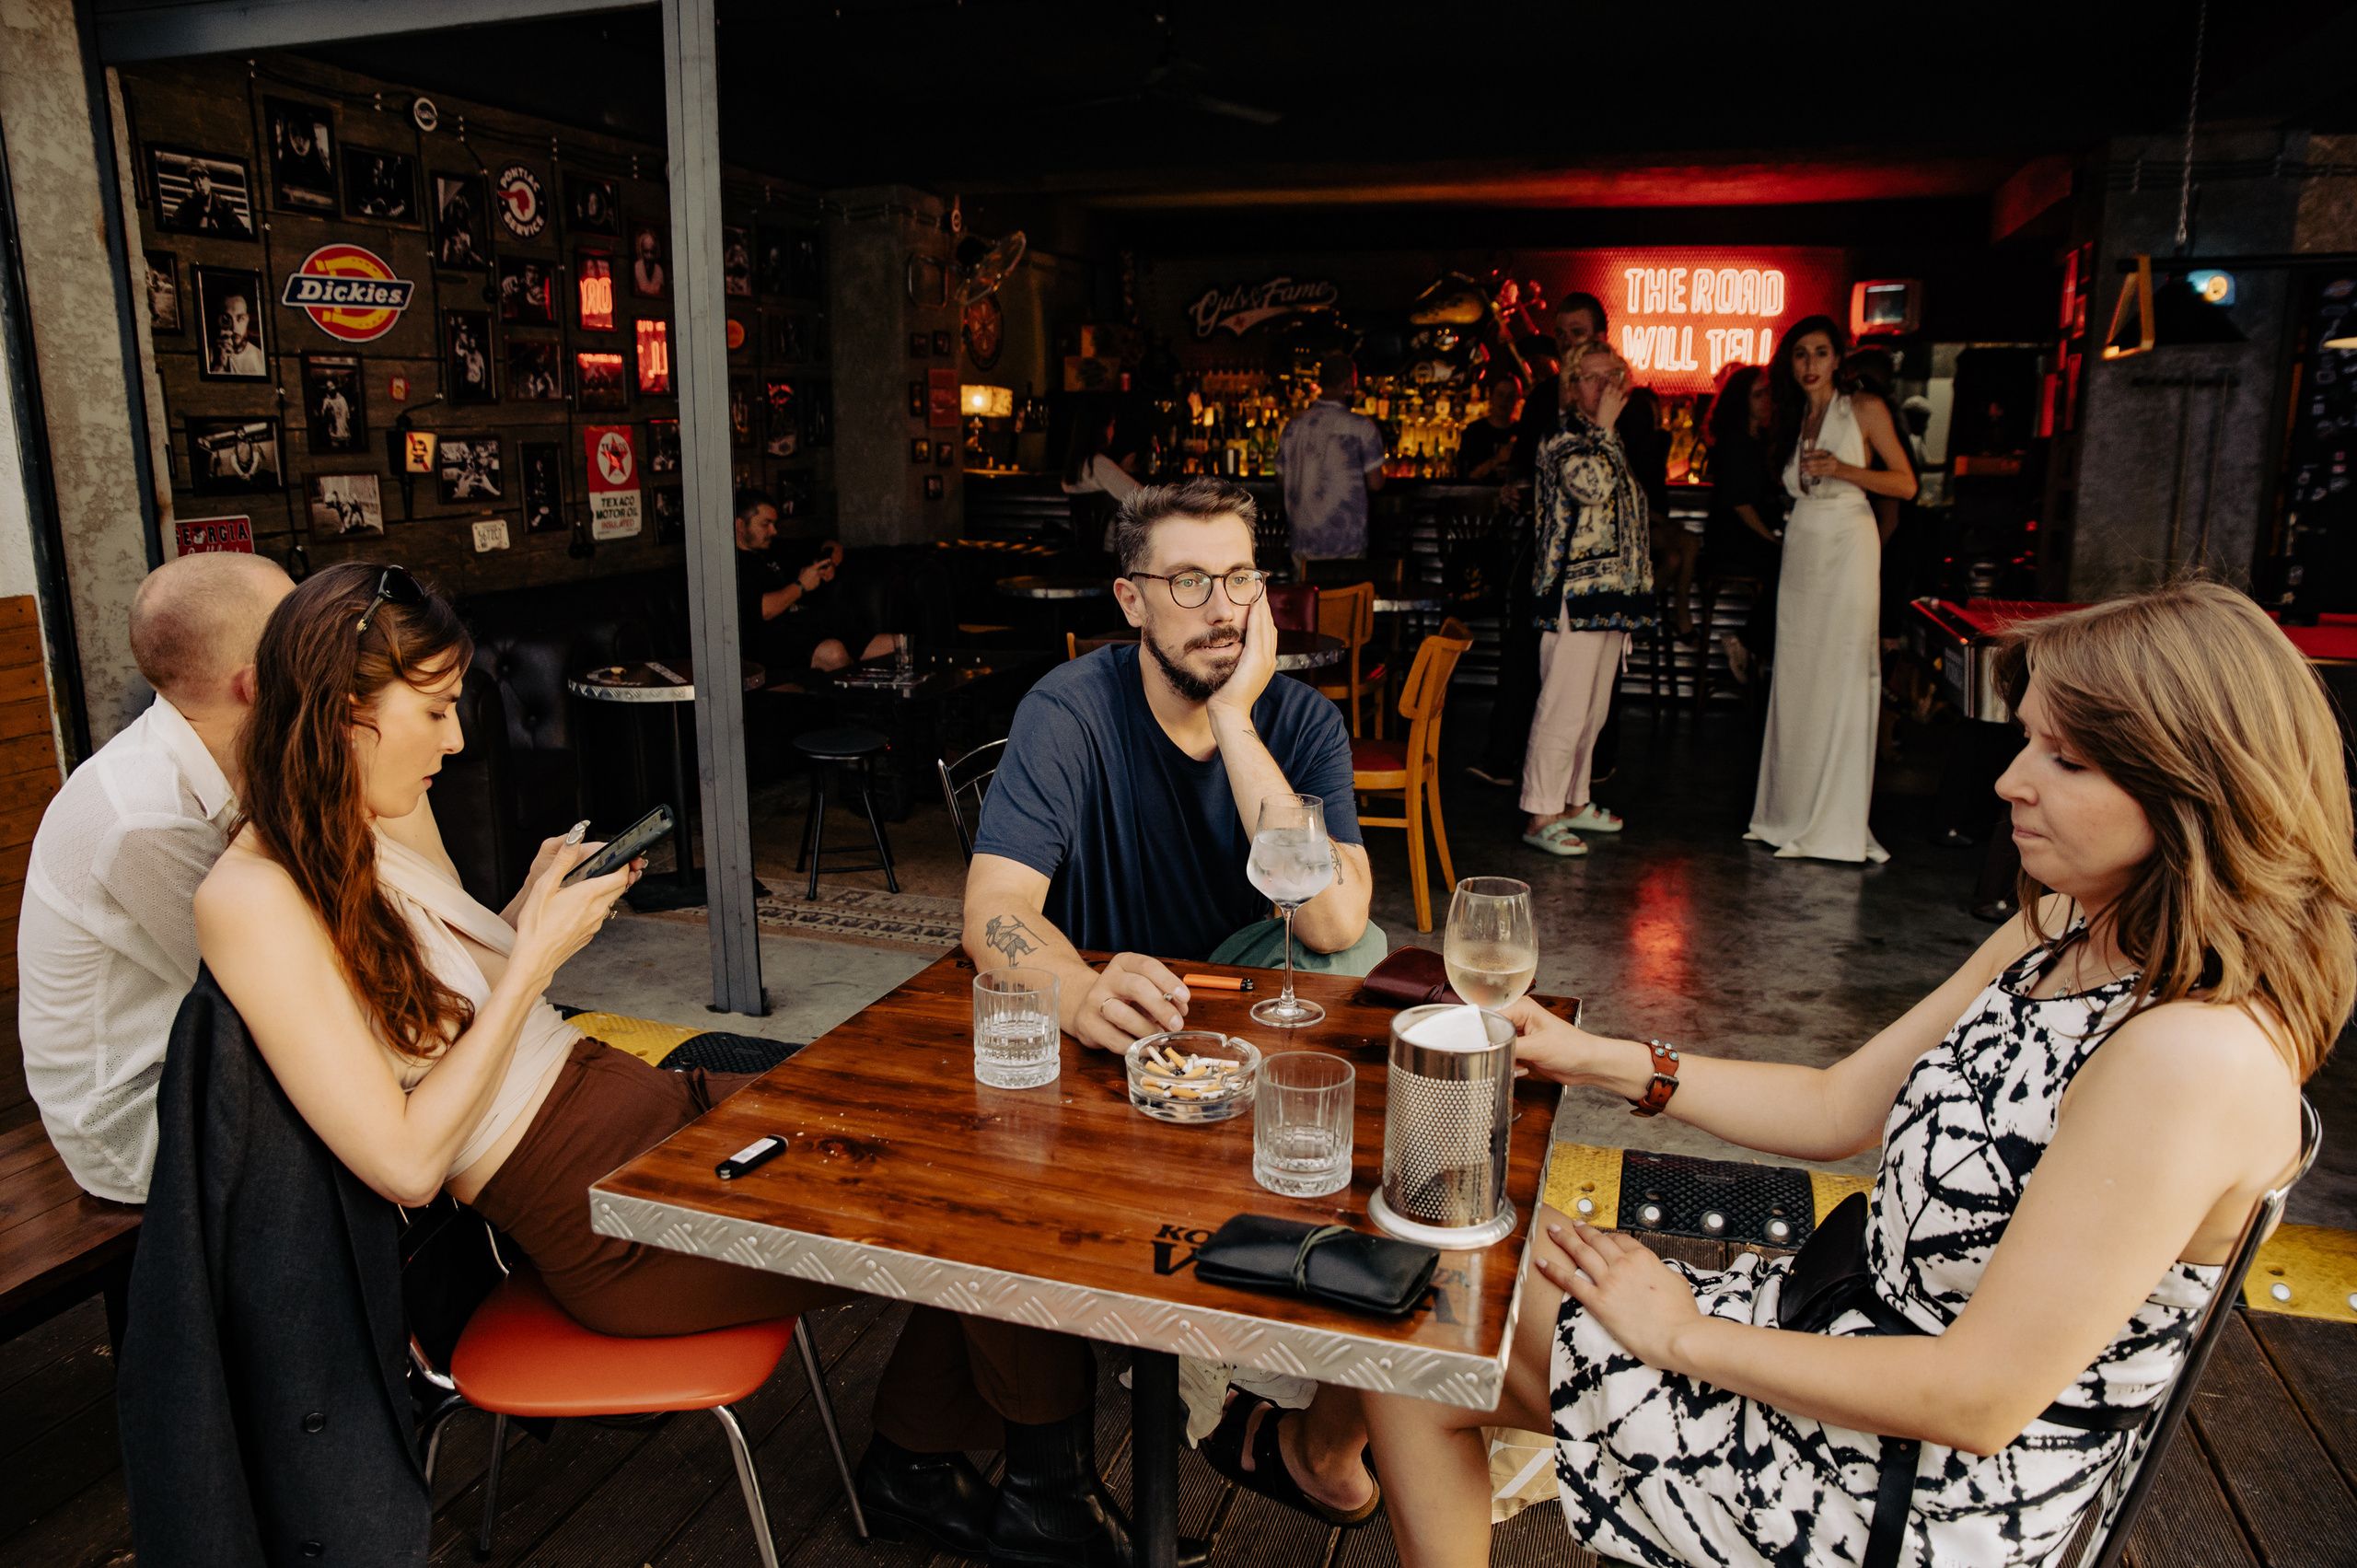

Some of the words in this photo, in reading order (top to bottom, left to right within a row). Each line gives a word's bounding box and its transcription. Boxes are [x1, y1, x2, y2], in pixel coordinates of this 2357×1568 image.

[500, 167, 540, 192] PONTIAC
[504, 211, 544, 237] SERVICE
[296, 279, 403, 305] Dickies
[1624, 267, 1688, 314] THE
[1690, 268, 1784, 317] ROAD
[1622, 324, 1699, 372] WILL
[595, 509, 625, 520] MOTOR
[627, 507, 639, 517] OIL
[600, 495, 635, 508] TEXACO
